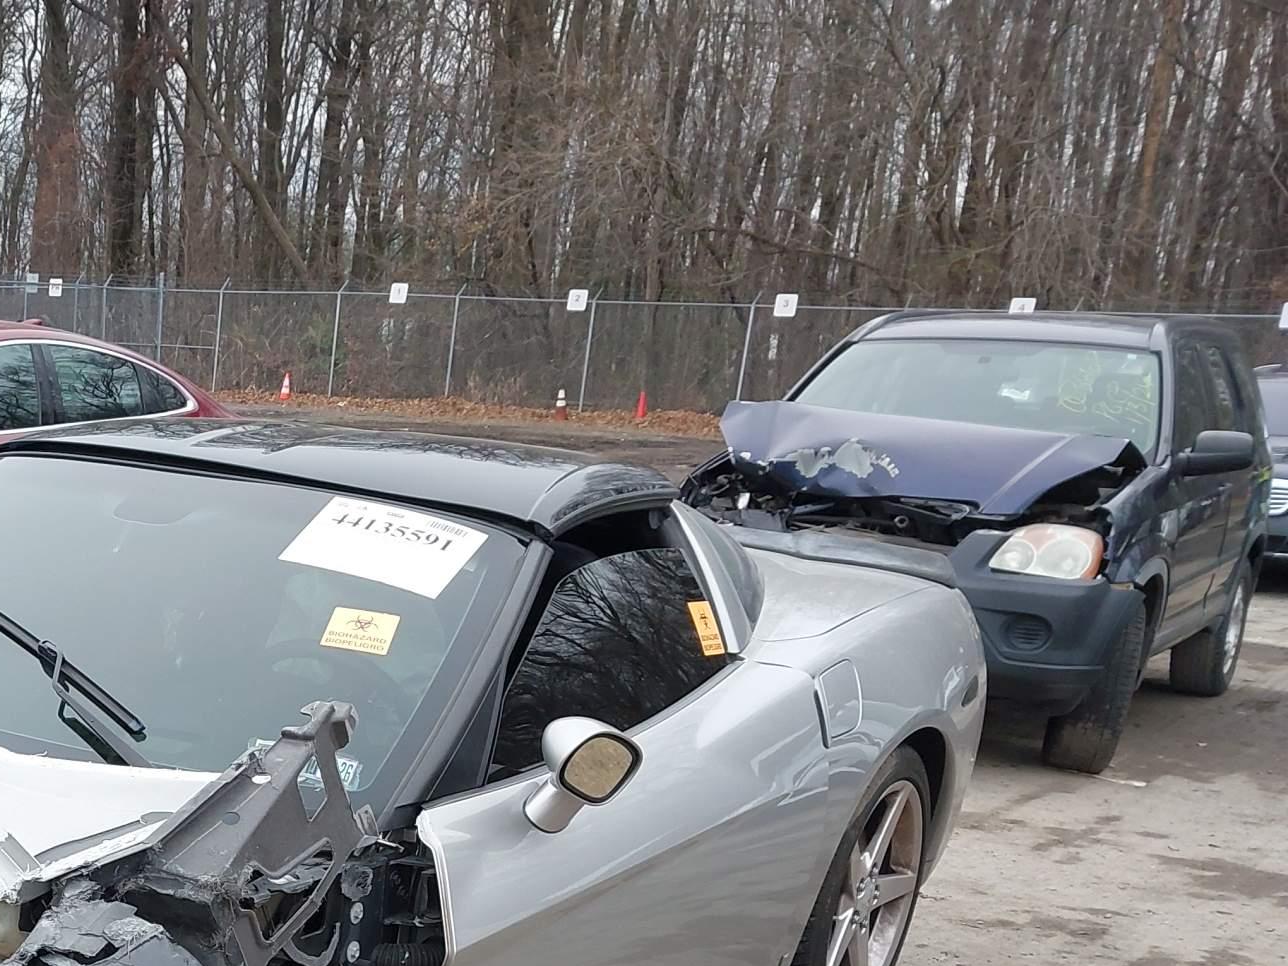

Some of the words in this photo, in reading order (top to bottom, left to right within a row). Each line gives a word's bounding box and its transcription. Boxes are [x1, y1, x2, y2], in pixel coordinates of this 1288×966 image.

[331, 513, 454, 551] 44135591
[325, 637, 385, 651] BIOPELIGRO
[328, 630, 387, 644] BIOHAZARD
